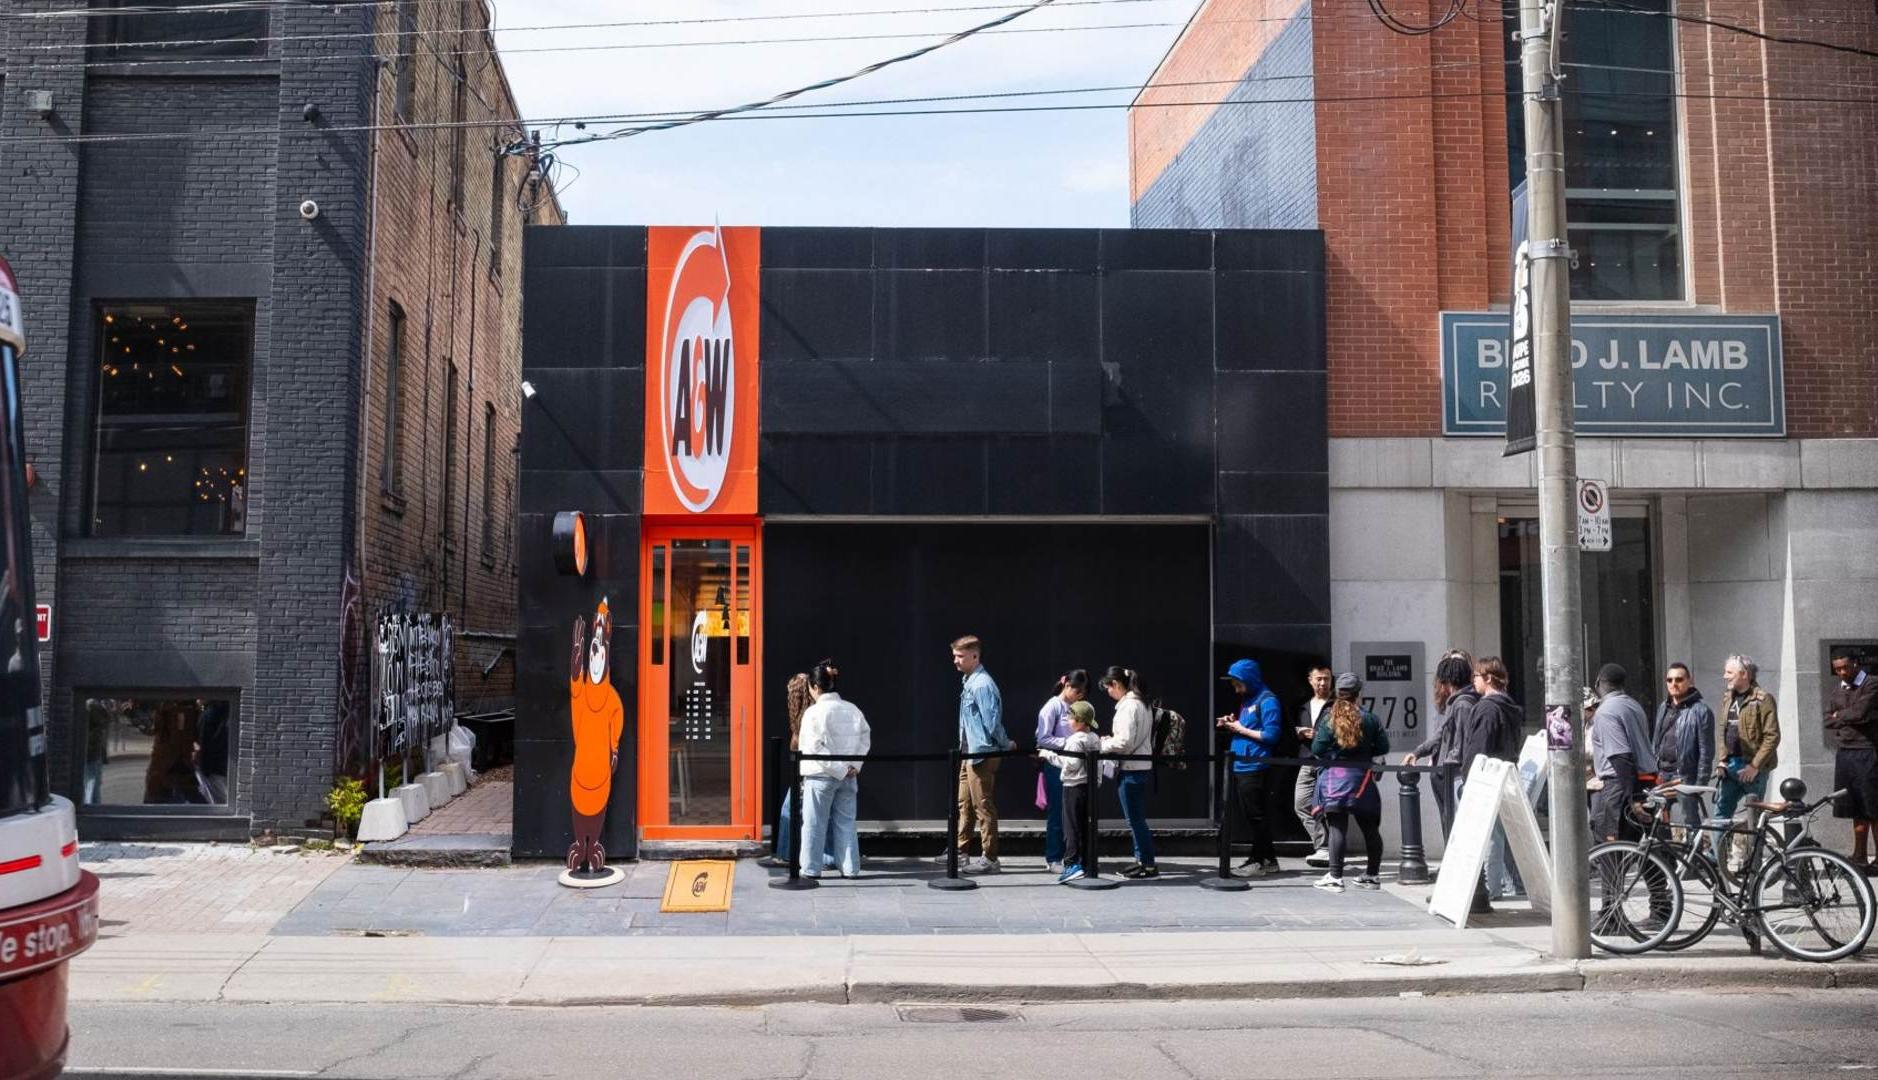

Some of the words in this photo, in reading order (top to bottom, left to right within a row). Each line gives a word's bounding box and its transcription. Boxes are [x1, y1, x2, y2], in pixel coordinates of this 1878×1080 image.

[1599, 340, 1629, 369] J.
[1639, 340, 1749, 370] LAMB
[672, 336, 731, 460] A&W
[1480, 381, 1644, 409] RLTY
[1667, 382, 1750, 409] INC.
[1361, 696, 1418, 730] 778
[0, 930, 17, 963] e
[23, 923, 73, 957] stop.
